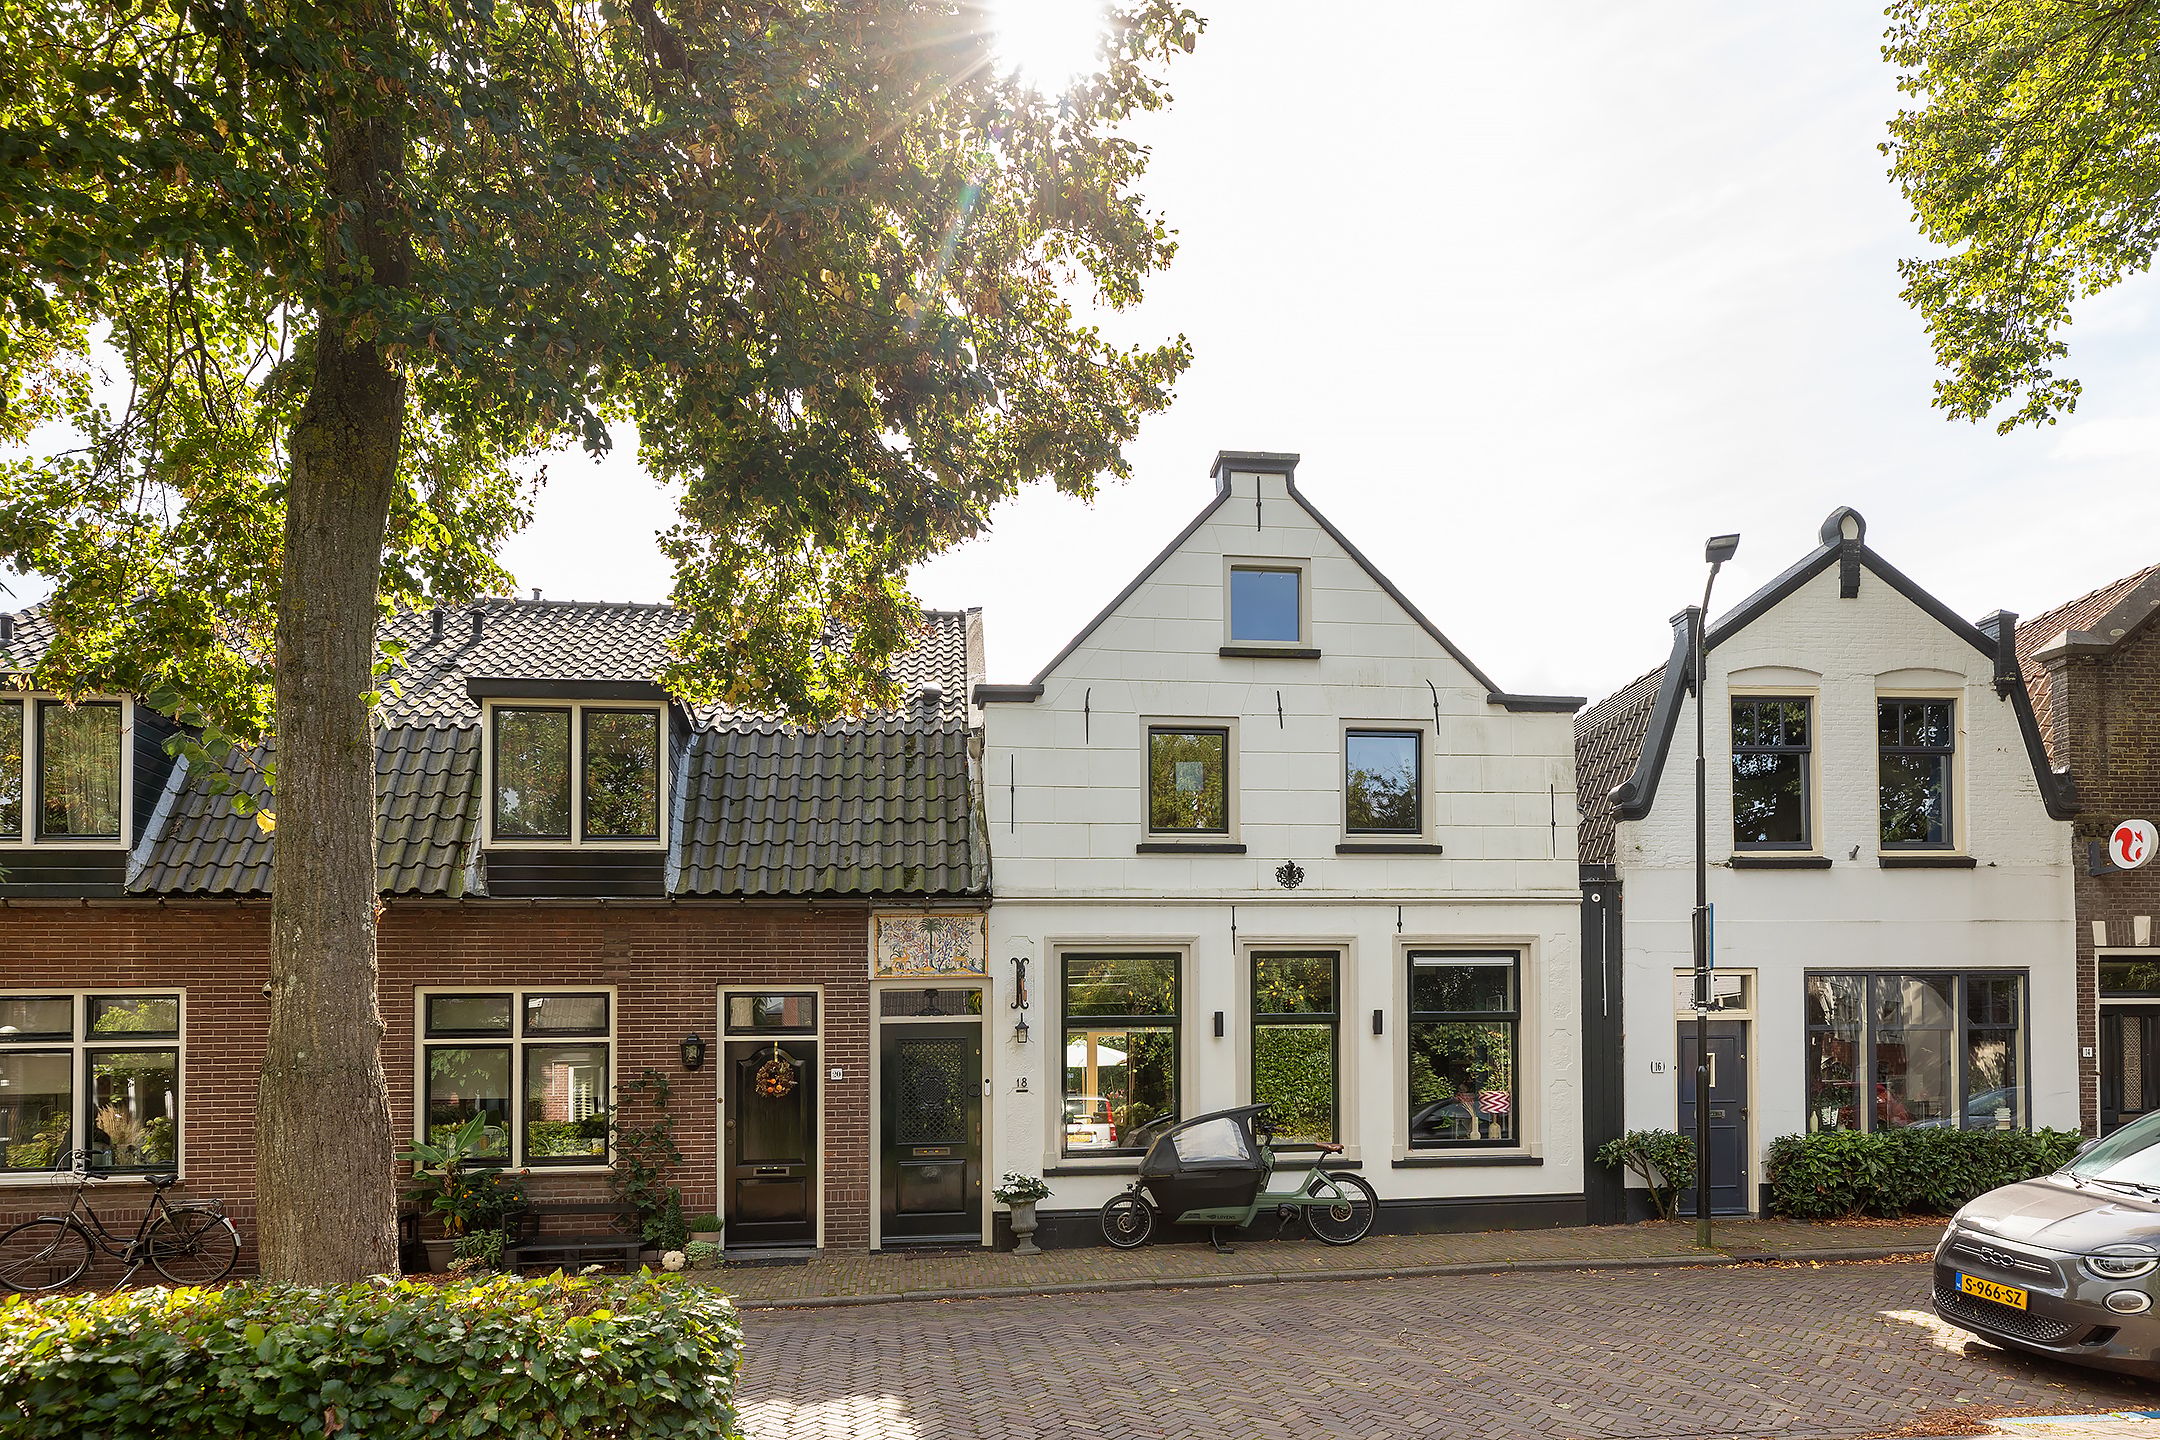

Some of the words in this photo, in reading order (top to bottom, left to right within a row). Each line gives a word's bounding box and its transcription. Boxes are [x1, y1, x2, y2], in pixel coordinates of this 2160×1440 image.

[1655, 1062, 1662, 1071] 16
[832, 1070, 841, 1078] 20
[1016, 1077, 1027, 1088] 18
[1979, 1246, 2015, 1267] 500
[1965, 1278, 2022, 1306] S-966-SZ
